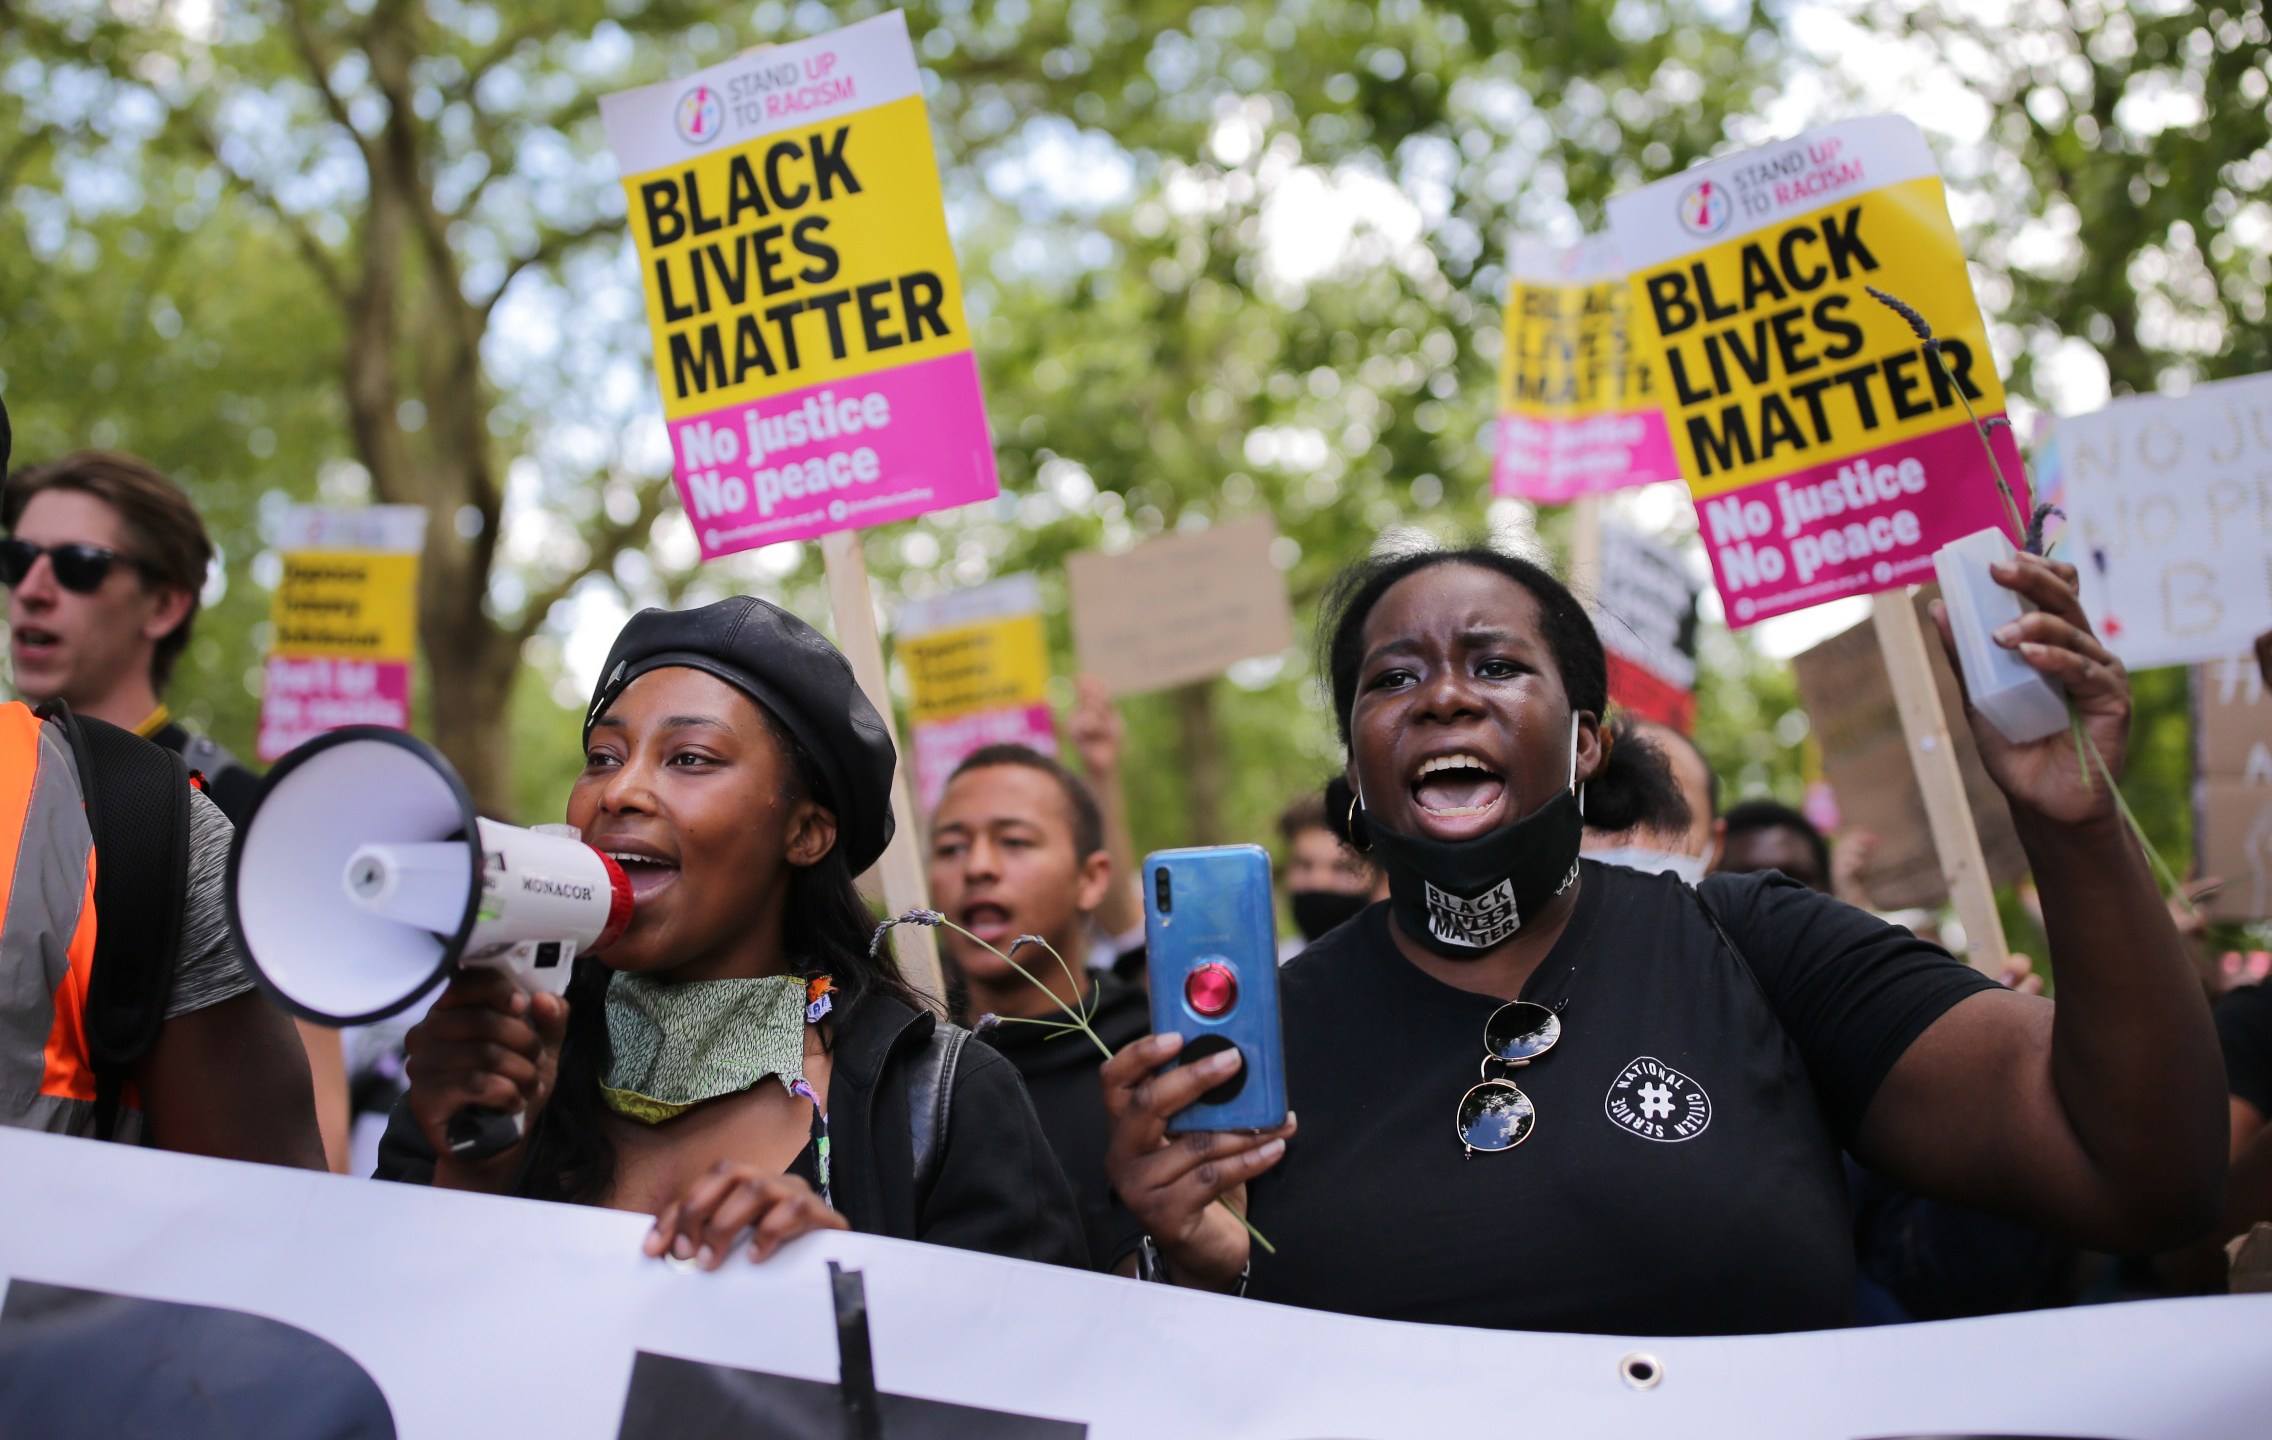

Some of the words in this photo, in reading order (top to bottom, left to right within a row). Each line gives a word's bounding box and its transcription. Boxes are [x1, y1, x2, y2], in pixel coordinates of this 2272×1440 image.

[727, 62, 799, 99] STAND
[803, 52, 838, 80] UP
[731, 103, 761, 129] TO
[765, 76, 857, 119] RACISM
[641, 125, 863, 248] BLACK
[1732, 151, 1804, 192] STAND
[1808, 136, 1844, 165] UP
[1740, 193, 1771, 219] TO
[1774, 158, 1866, 207] RACISM
[655, 215, 840, 324] LIVES
[1646, 205, 1880, 338] BLACK
[668, 270, 952, 400] MATTER
[1667, 294, 1865, 407] LIVES
[679, 420, 740, 473] No
[744, 389, 891, 468] justice
[1685, 338, 1985, 478] MATTER
[687, 469, 748, 520] No
[753, 446, 881, 517] peace
[2074, 416, 2184, 483] NO
[1705, 494, 1773, 547] No
[1776, 457, 1927, 540] justice
[1718, 541, 1787, 593] No
[1790, 509, 1922, 583] peace
[1428, 883, 1509, 915] BLACK
[1431, 904, 1507, 931] LIVES
[1433, 918, 1516, 945] MATTER
[1617, 1061, 1684, 1090] NATIONAL
[1610, 1097, 1664, 1138] SERVICE
[1673, 1093, 1706, 1136] CITIZEN
